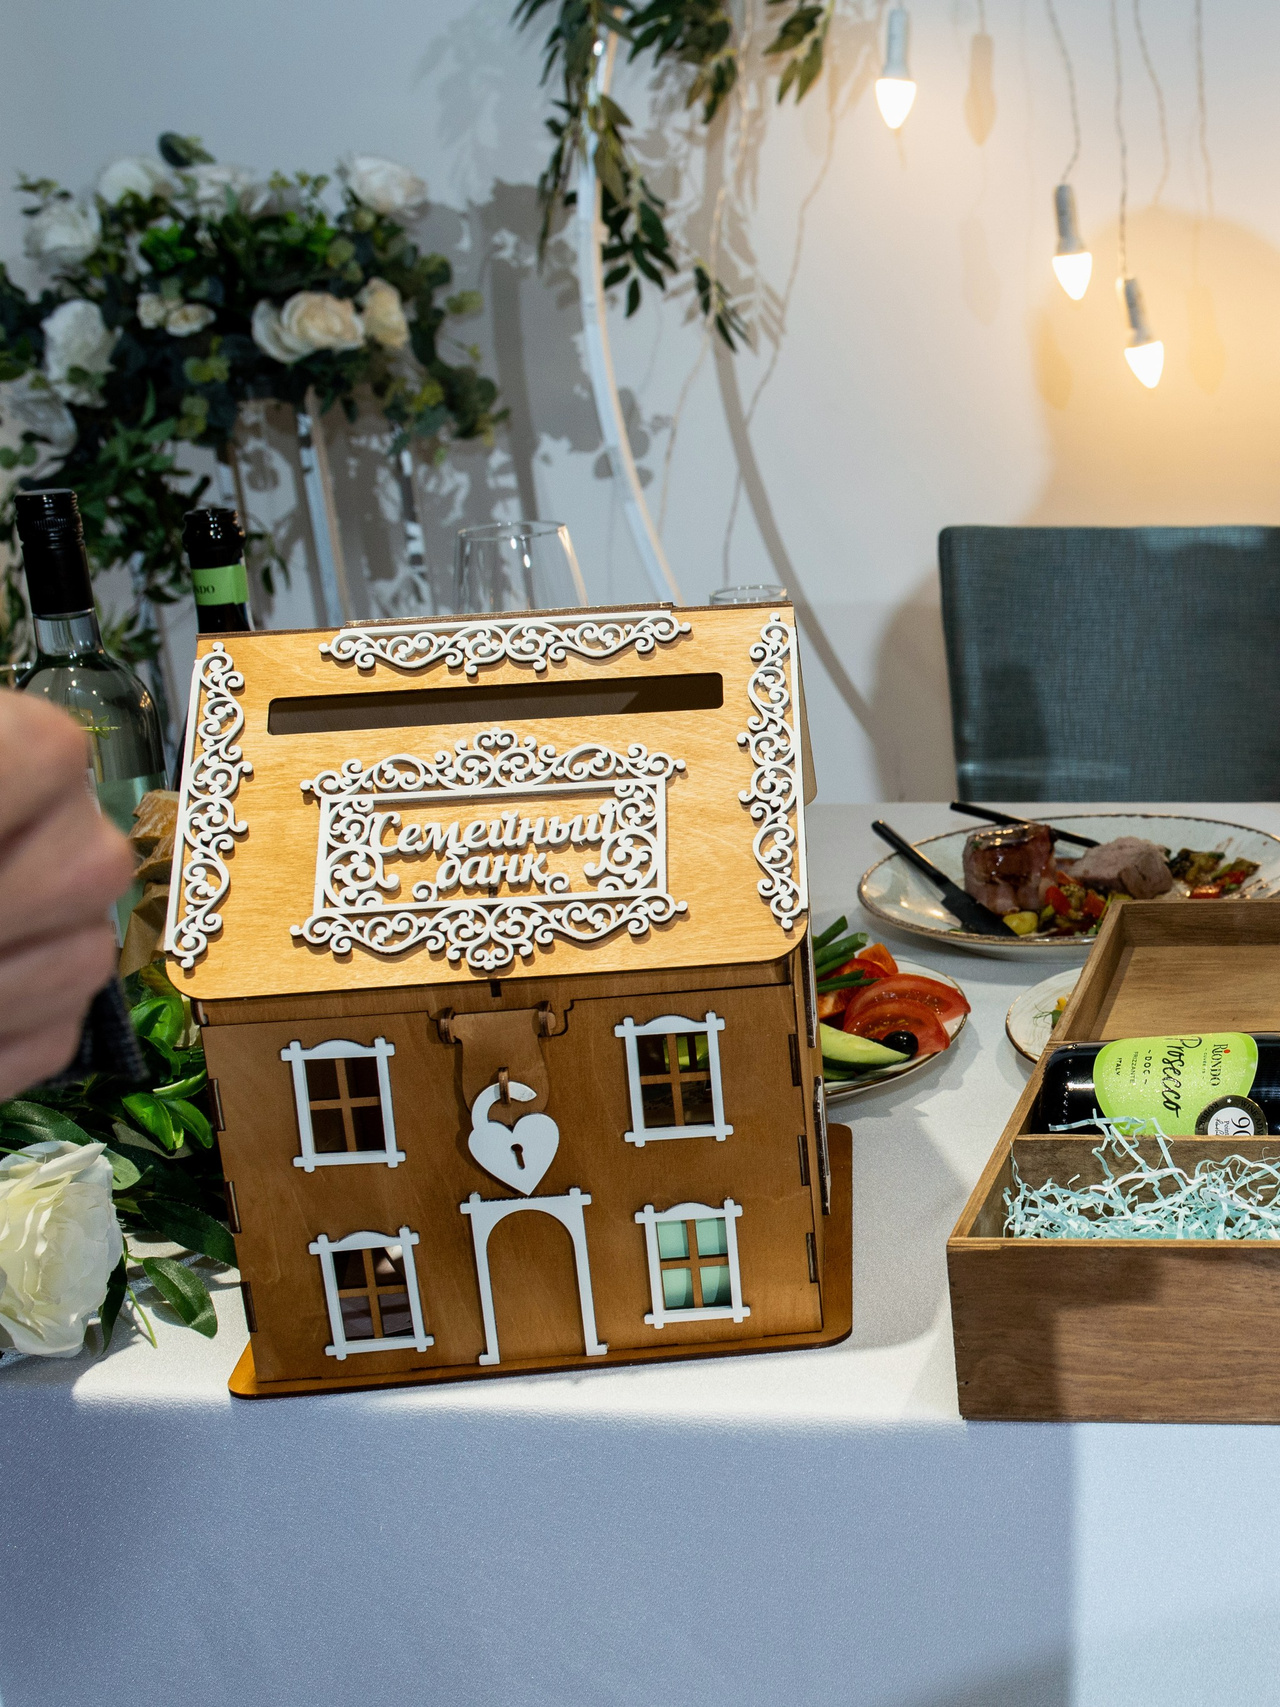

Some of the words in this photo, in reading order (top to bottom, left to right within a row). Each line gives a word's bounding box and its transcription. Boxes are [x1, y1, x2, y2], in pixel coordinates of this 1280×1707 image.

[367, 800, 616, 854] Семейный
[435, 849, 549, 891] банк
[1162, 1036, 1202, 1118] Prosecco
[1197, 1101, 1219, 1131] ROBERT
